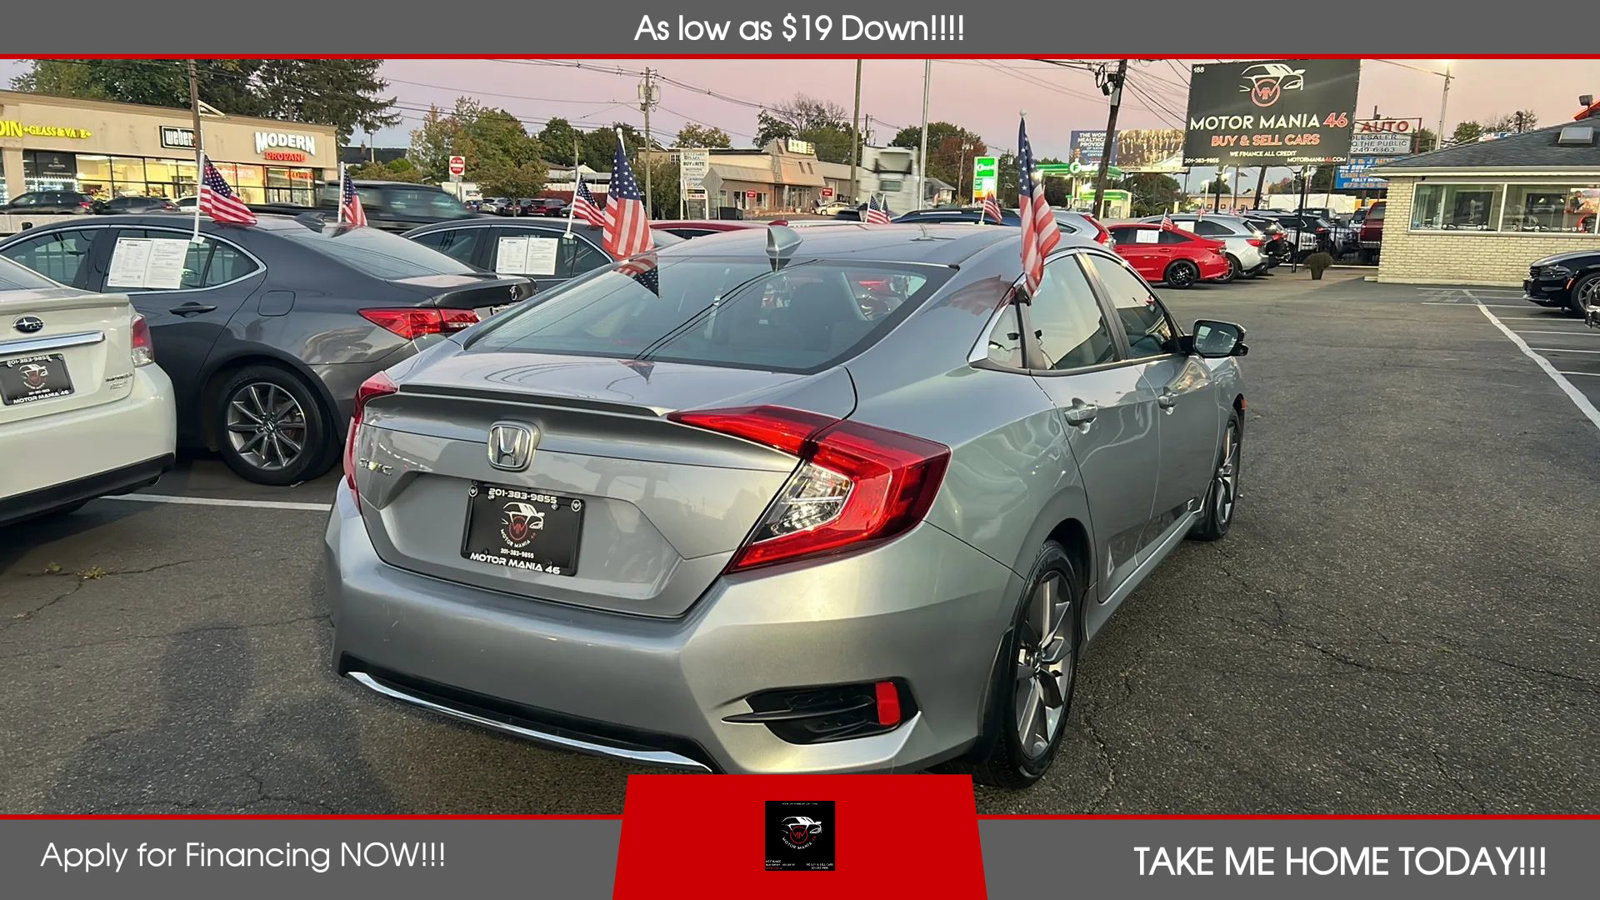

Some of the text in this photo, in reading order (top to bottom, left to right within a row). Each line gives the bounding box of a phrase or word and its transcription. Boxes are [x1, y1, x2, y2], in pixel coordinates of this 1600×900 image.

[1189, 112, 1349, 131] MOTOR MANIA 46
[1361, 120, 1409, 133] AUTO
[29, 125, 56, 136] GLASS
[255, 131, 316, 156] MODERN
[1210, 133, 1321, 147] BUY & SELL CARS
[488, 488, 558, 504] 201-383-9855
[470, 552, 561, 575] MOTOR MANIA 46
